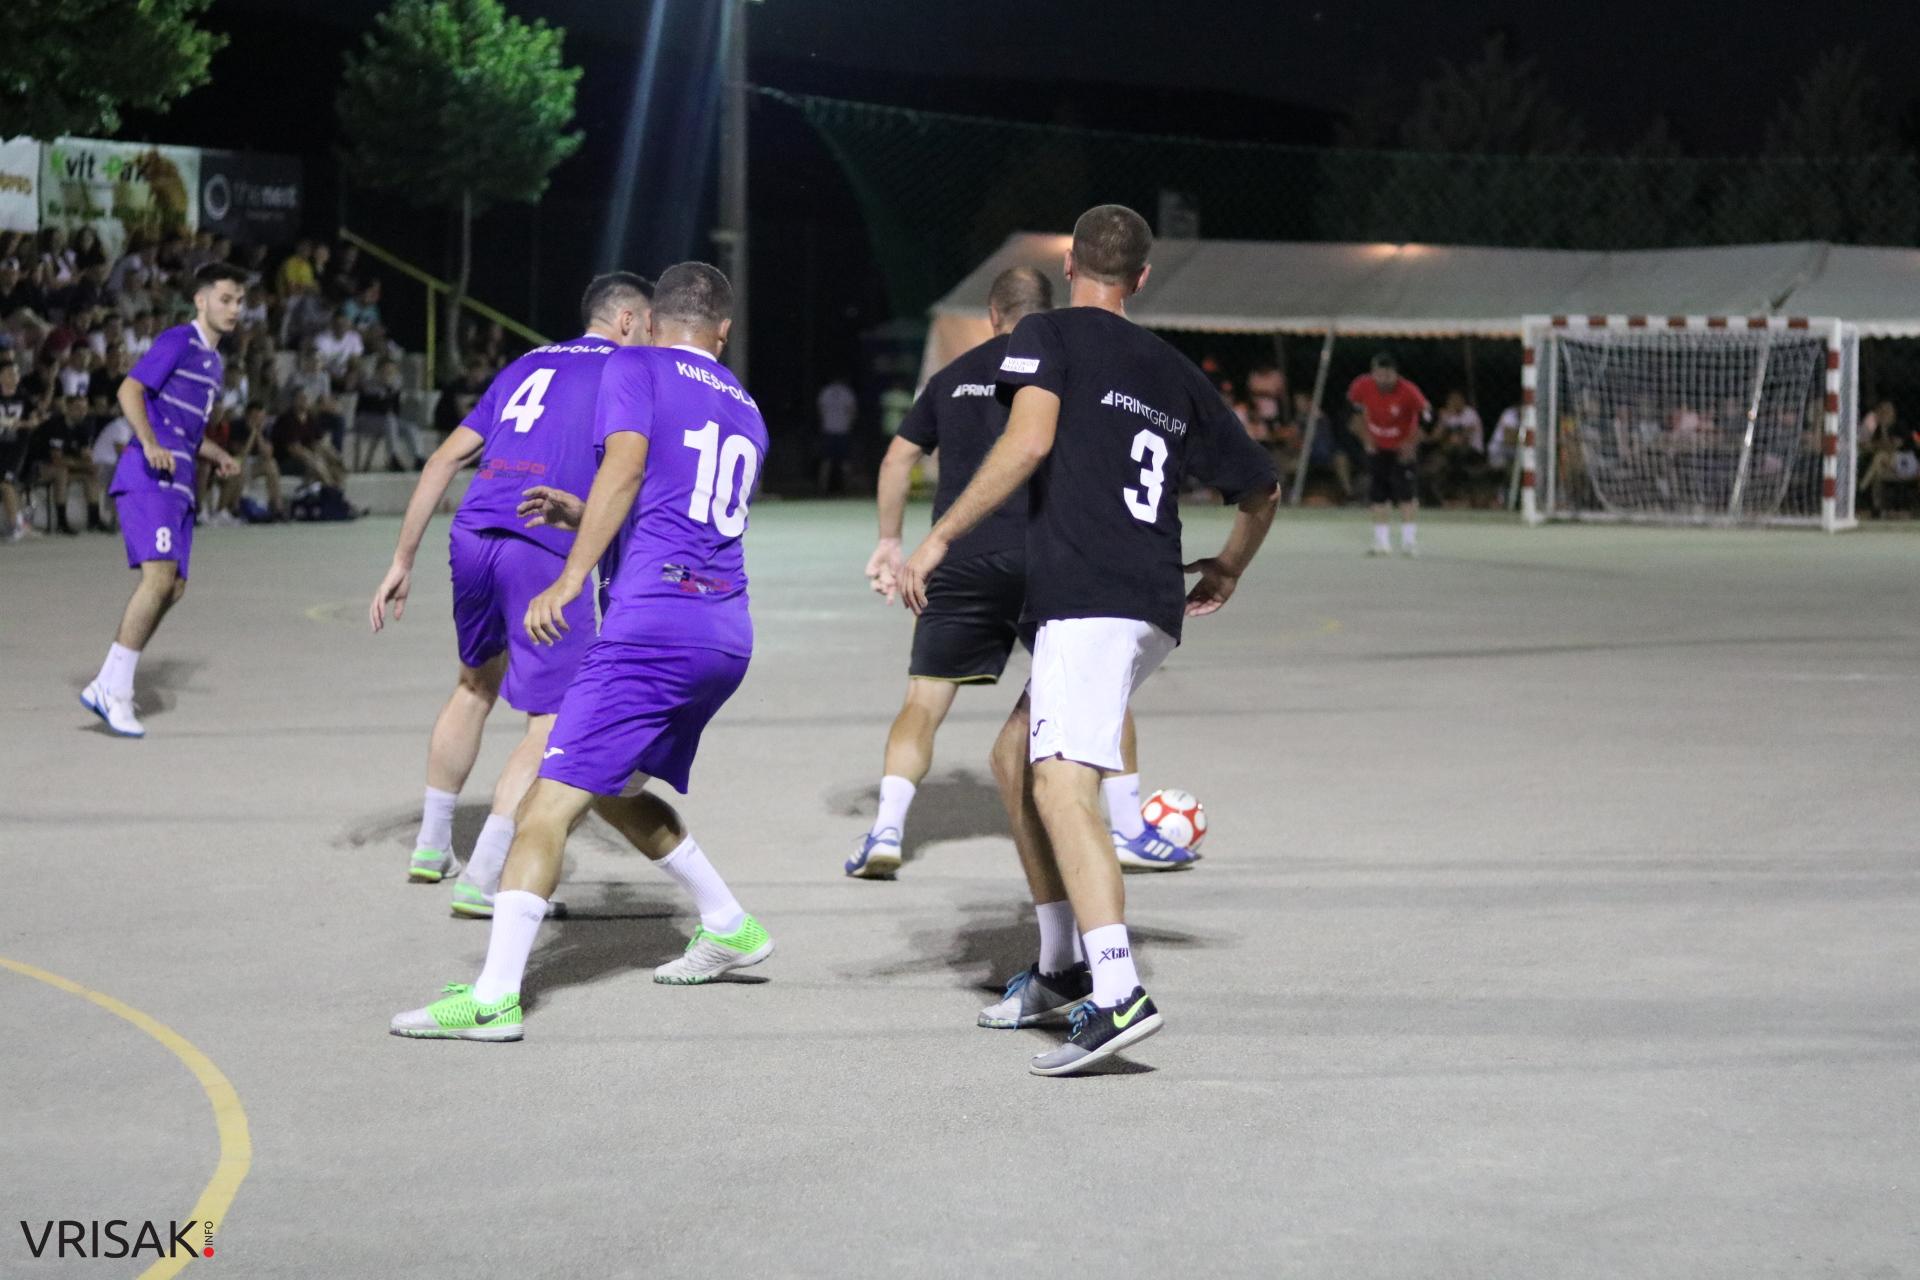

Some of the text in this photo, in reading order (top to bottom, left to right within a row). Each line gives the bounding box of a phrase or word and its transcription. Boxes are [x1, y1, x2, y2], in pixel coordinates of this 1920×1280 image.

[501, 368, 556, 433] 4
[960, 384, 996, 397] PRINT
[1115, 393, 1187, 436] PRINTGRUPA
[683, 420, 757, 537] 10
[1124, 429, 1169, 524] 3
[155, 526, 172, 553] 8
